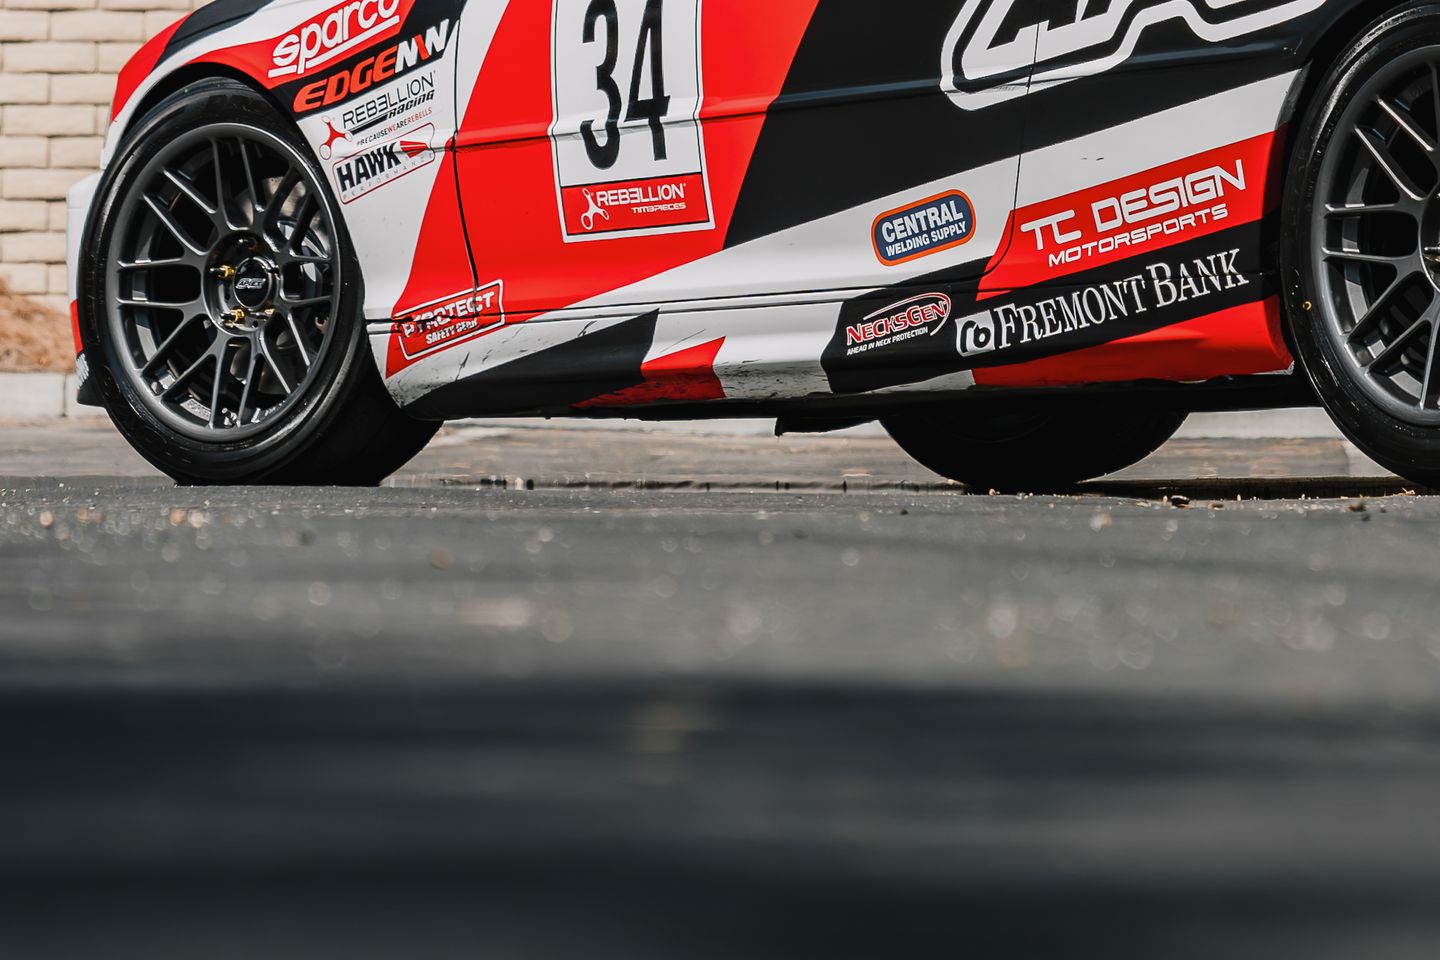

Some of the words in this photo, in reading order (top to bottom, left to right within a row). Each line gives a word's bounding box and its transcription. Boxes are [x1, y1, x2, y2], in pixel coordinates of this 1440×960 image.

[336, 141, 402, 193] HAWK
[881, 200, 964, 243] CENTRAL
[1020, 209, 1083, 251] TC
[1091, 159, 1247, 233] DESIGN
[885, 233, 931, 257] WELDING
[931, 220, 967, 243] SUPPLY
[1048, 203, 1229, 268] MOTORSPORTS
[993, 274, 1148, 350] FREMONT
[1146, 248, 1250, 308] BANK
[846, 343, 868, 356] AHEAD
[868, 341, 876, 351] IN
[875, 337, 892, 349] NECK
[892, 326, 929, 343] PROTECTION
